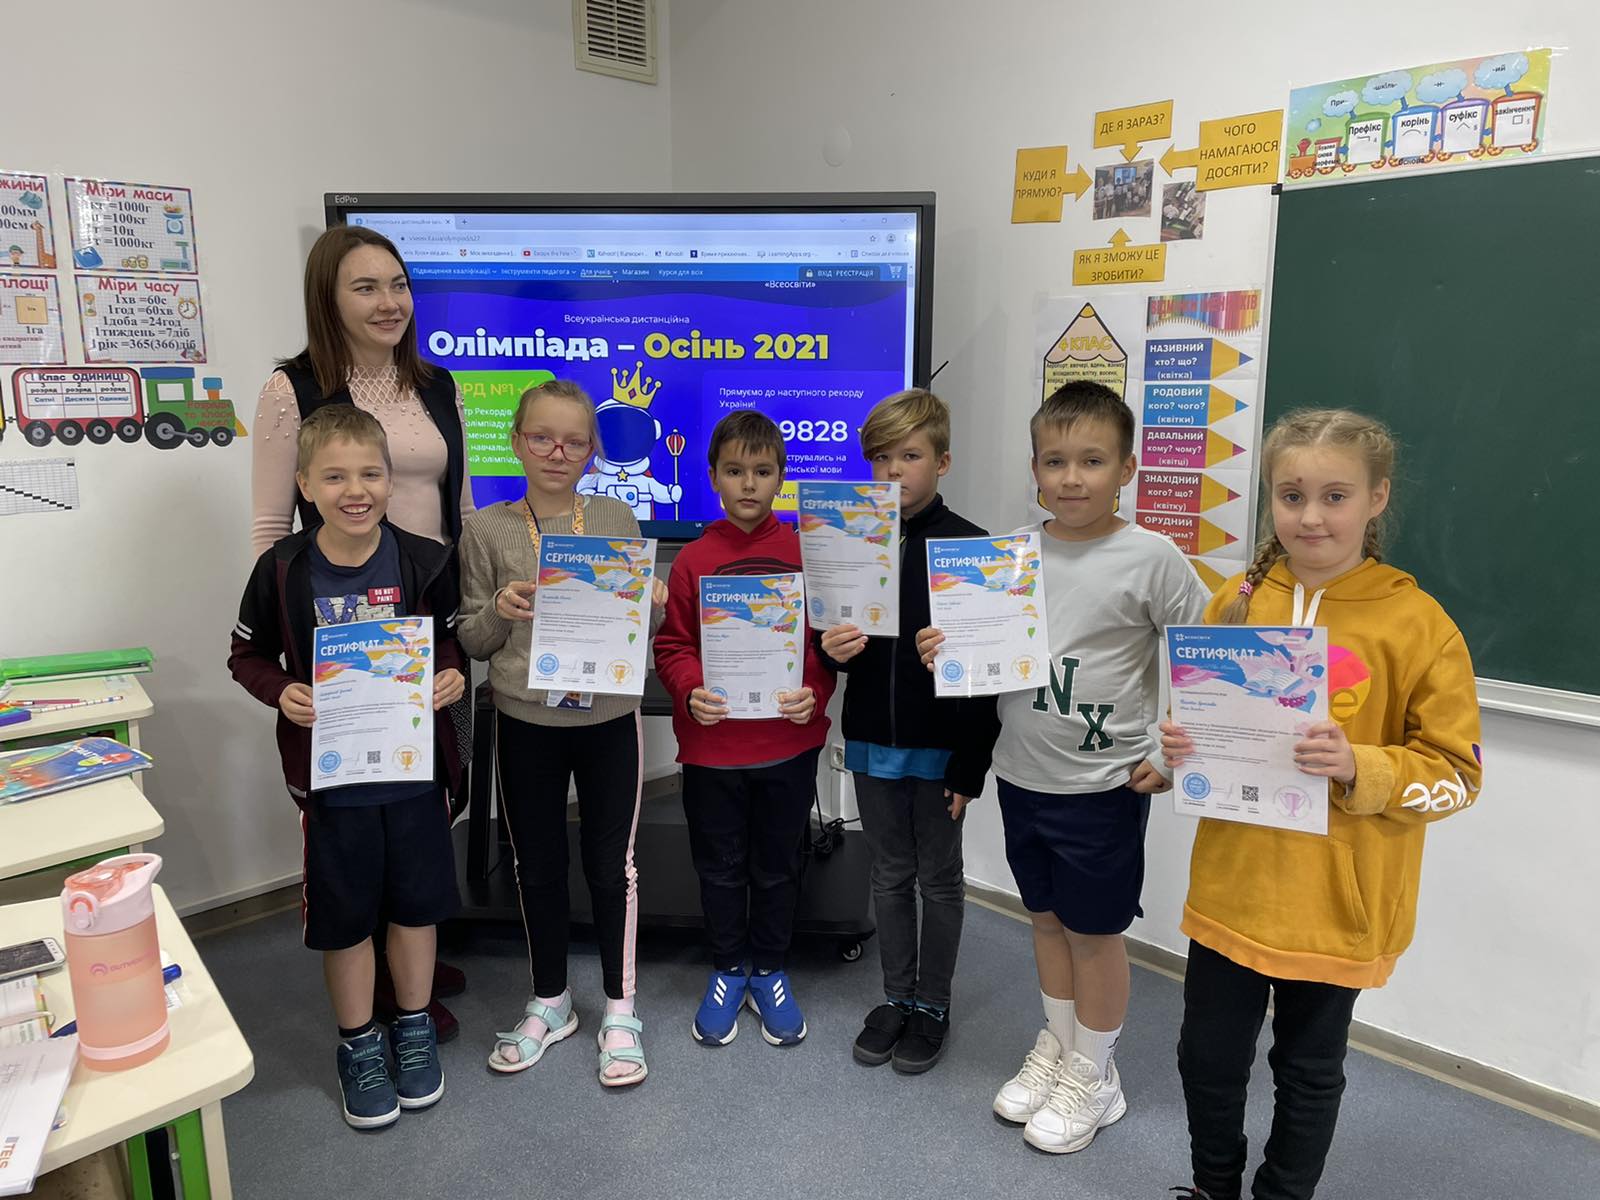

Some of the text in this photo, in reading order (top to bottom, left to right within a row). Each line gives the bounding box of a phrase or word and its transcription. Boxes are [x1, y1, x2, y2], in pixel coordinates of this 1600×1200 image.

[1400, 116, 1430, 127] корінь
[1449, 111, 1478, 123] суфікс
[1100, 112, 1165, 136] ДЕ Я ЗАРАЗ?
[1223, 122, 1256, 137] ЧОГО
[1349, 124, 1381, 135] Префікс
[1199, 139, 1279, 161] НАМАГАЮСЯ
[1023, 169, 1056, 182] КУДИ Я
[1205, 161, 1269, 182] ДОСЯГТИ?
[133, 190, 174, 202] маси
[1015, 187, 1062, 200] ПРЯМУЮ?
[334, 195, 359, 204] EdPro
[1078, 249, 1160, 265] ЯК Я ЗМОЖУ ЦЕ
[1091, 269, 1144, 283] ЗРОБИТИ?
[98, 278, 180, 297] Міри часу
[764, 281, 816, 289] «Всеосвіти»
[115, 294, 136, 305] 1хв
[108, 304, 136, 316] 1год
[103, 316, 182, 327] 1доба =24год
[564, 314, 690, 324] Всеукраїнська дистанційна
[95, 327, 156, 337] 1тиждень
[428, 328, 609, 362] Олімпіада
[644, 329, 745, 360] Осінь
[753, 333, 829, 360] 2021
[1070, 335, 1113, 351] КЛАС
[1150, 344, 1204, 353] НАЗИВНИЙ
[1155, 358, 1197, 367] хто? що?
[40, 373, 66, 381] Клас
[72, 373, 124, 383] ОДИНИЦІ
[1157, 371, 1193, 380] (квітка)
[490, 383, 514, 396] №1
[719, 387, 864, 398] Прямуємо до наступного рекорду
[1153, 388, 1203, 398] РОДОВИЙ
[719, 400, 756, 409] України!
[1148, 402, 1205, 411] кого? чого?
[475, 408, 512, 417] Рекордів
[465, 419, 505, 429] олімпіаду
[1157, 415, 1194, 425] (квітки)
[779, 420, 848, 442] 9828
[1147, 431, 1204, 441] ДАВАЛЬНИЙ
[1147, 445, 1202, 454] кому? чому?
[786, 455, 834, 463] струвались
[1158, 458, 1189, 467] (квітці)
[1144, 474, 1199, 485] ЗНАХІДНИЙ
[1147, 489, 1193, 499] кого? що?
[1153, 501, 1187, 512] (квітку)
[1144, 516, 1193, 527] ОРУДНИЙ
[545, 552, 606, 564] СЕРТИФІКАТ
[934, 556, 992, 568] СЕРТИФІКАТ
[705, 593, 761, 603] СЕРТИФІКАТ
[320, 639, 379, 657] СЕРТИФІКАТ
[1175, 647, 1255, 660] СЕРТИФІКАТ
